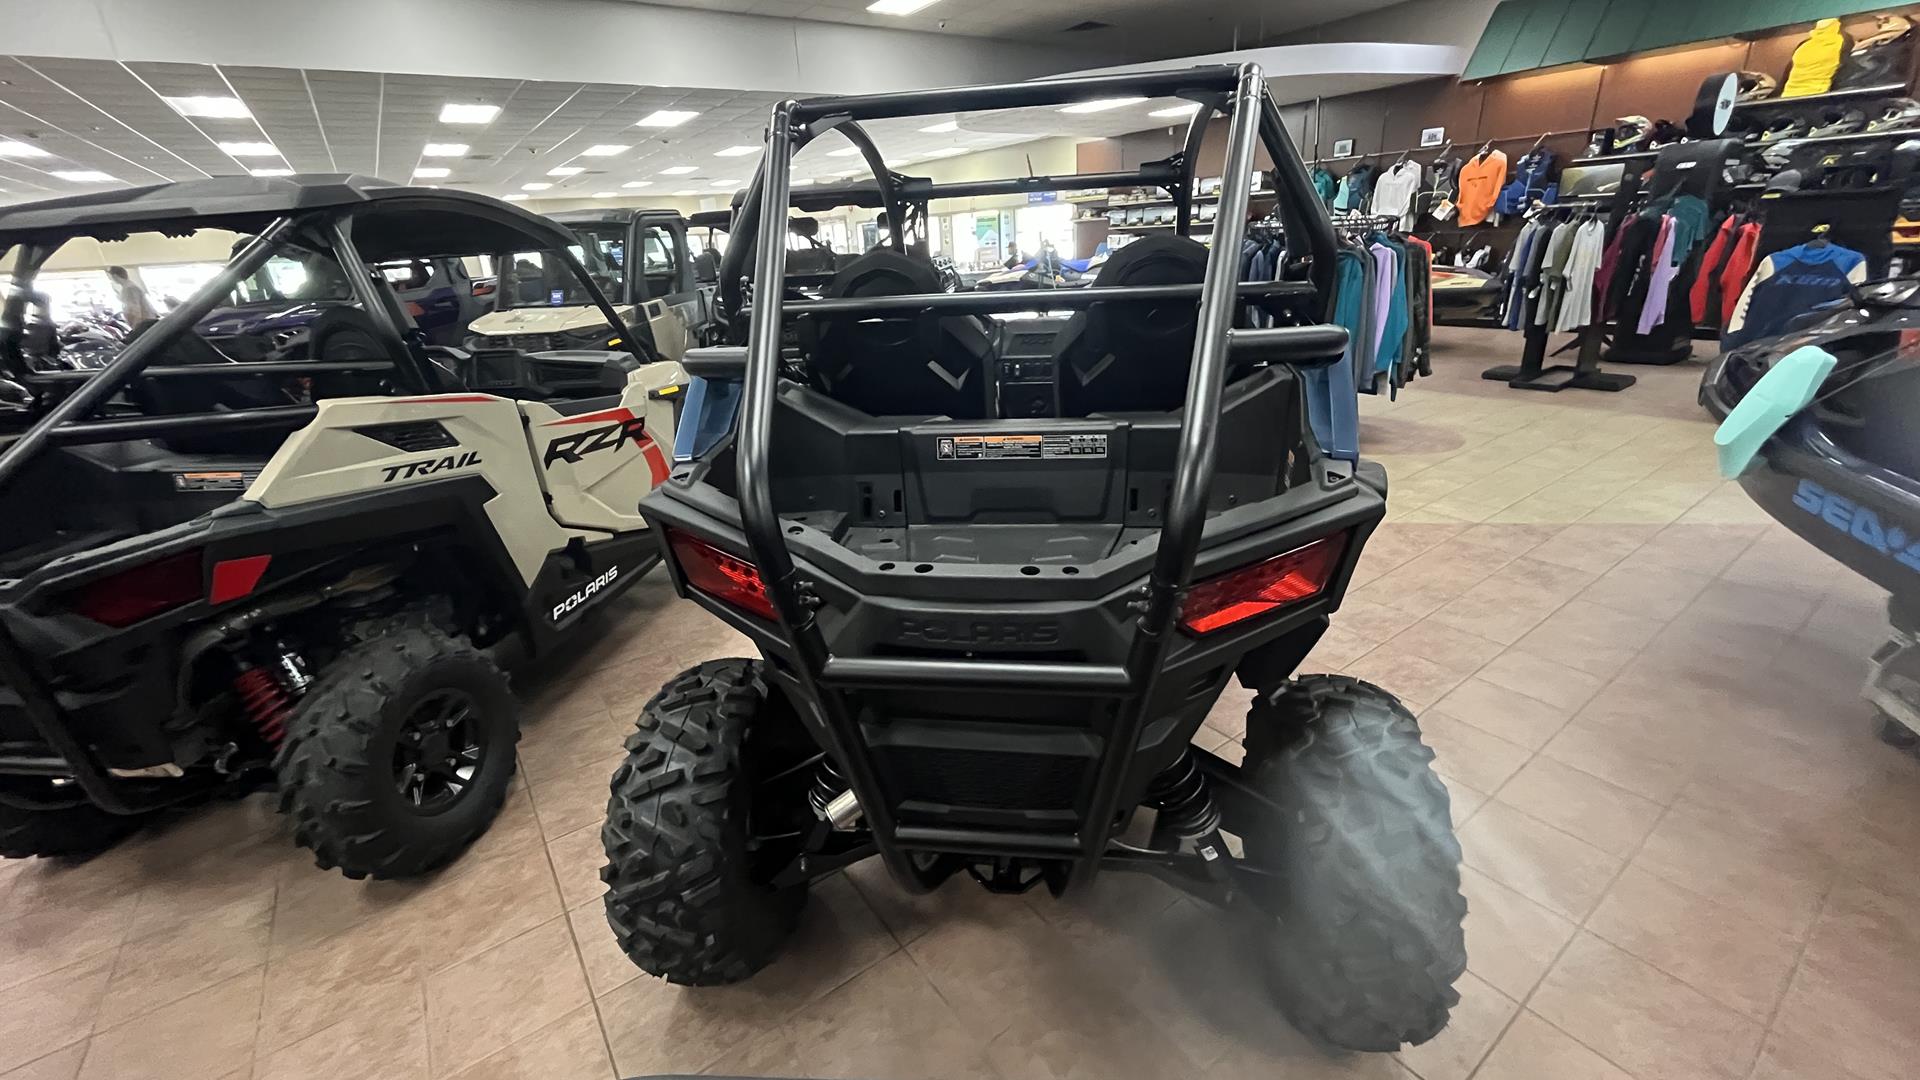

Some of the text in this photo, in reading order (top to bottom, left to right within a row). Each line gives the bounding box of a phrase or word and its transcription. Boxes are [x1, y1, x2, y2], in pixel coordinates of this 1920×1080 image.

[543, 416, 648, 471] RZR
[381, 451, 482, 482] TRAIL
[553, 565, 618, 620] POLARIS
[898, 620, 1059, 645] POLARIS
